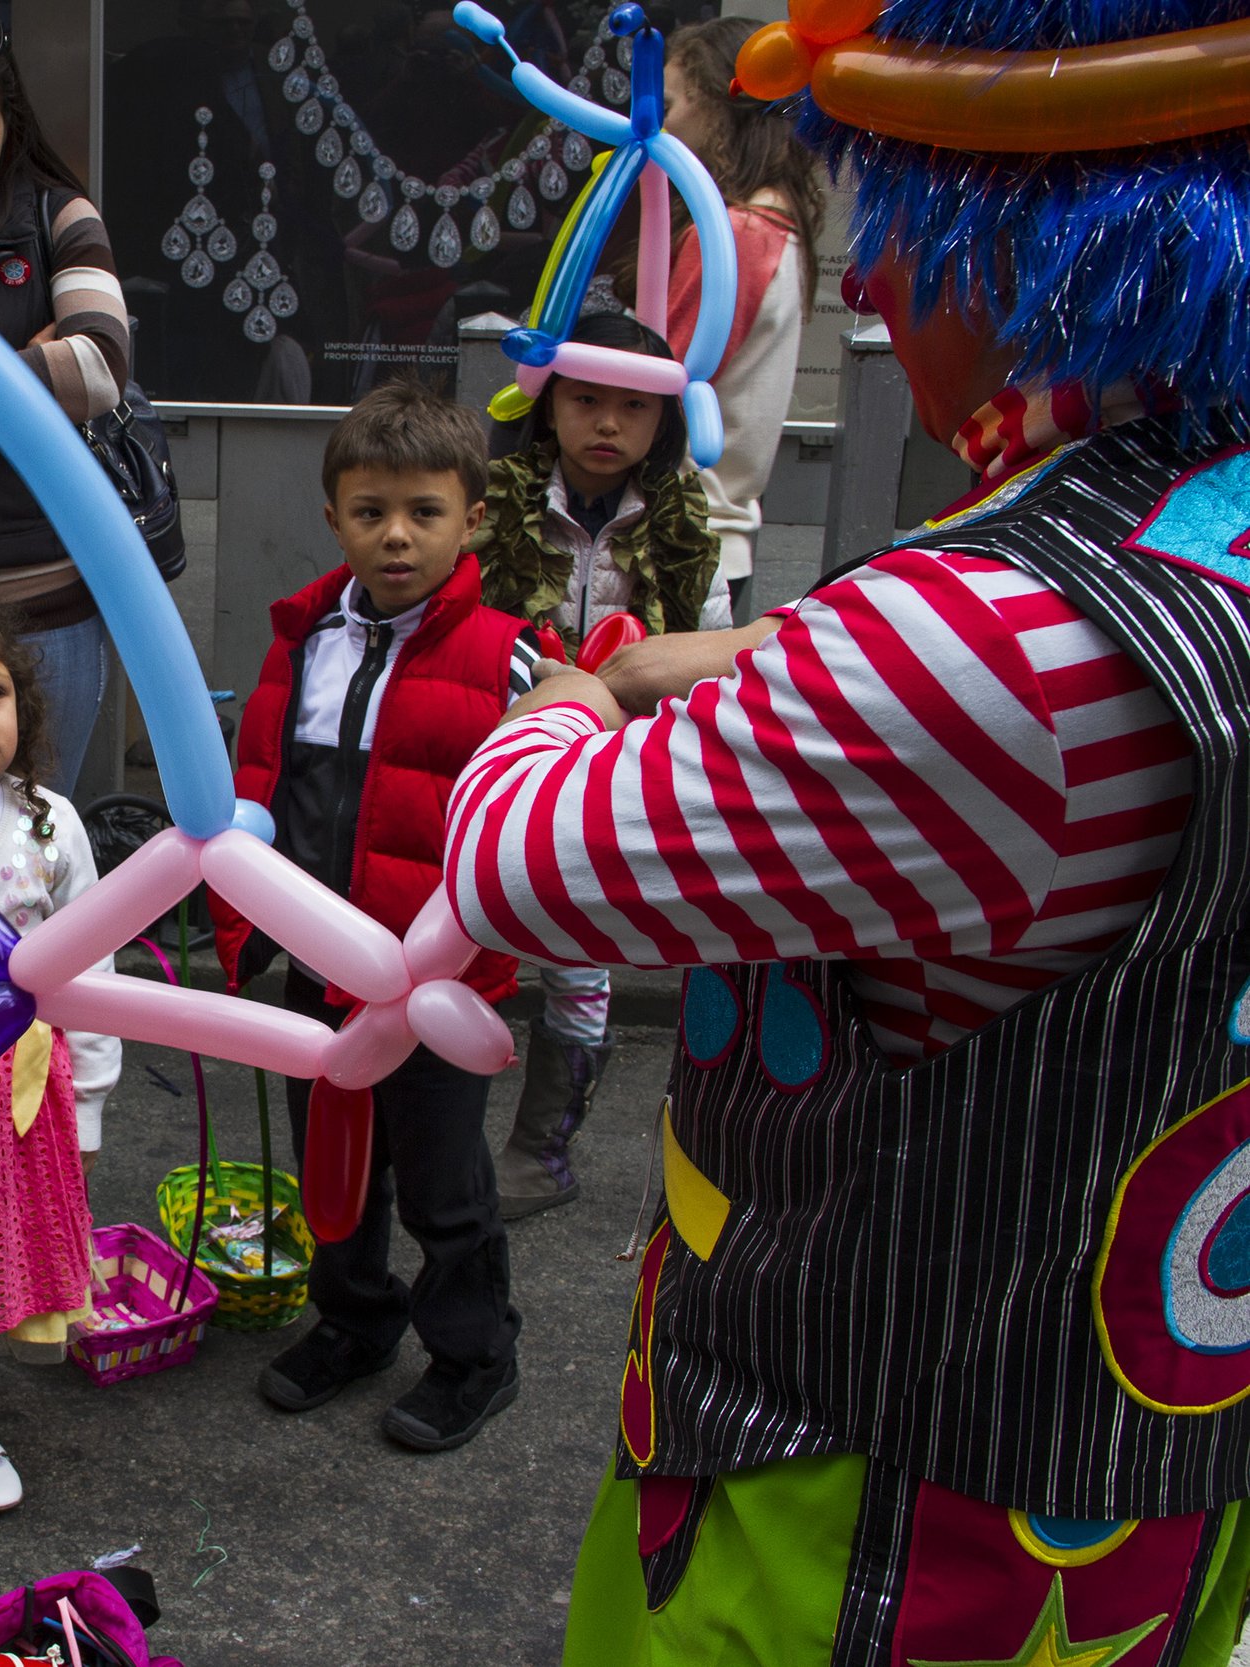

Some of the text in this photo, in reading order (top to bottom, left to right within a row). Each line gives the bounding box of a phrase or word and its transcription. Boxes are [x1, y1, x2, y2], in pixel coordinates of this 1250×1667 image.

[324, 342, 396, 352] UNFORGETTABLE
[398, 344, 426, 353] WHITE
[324, 352, 349, 361] FROM
[350, 353, 369, 361] OUR
[371, 354, 418, 363] EXCLUSIVE
